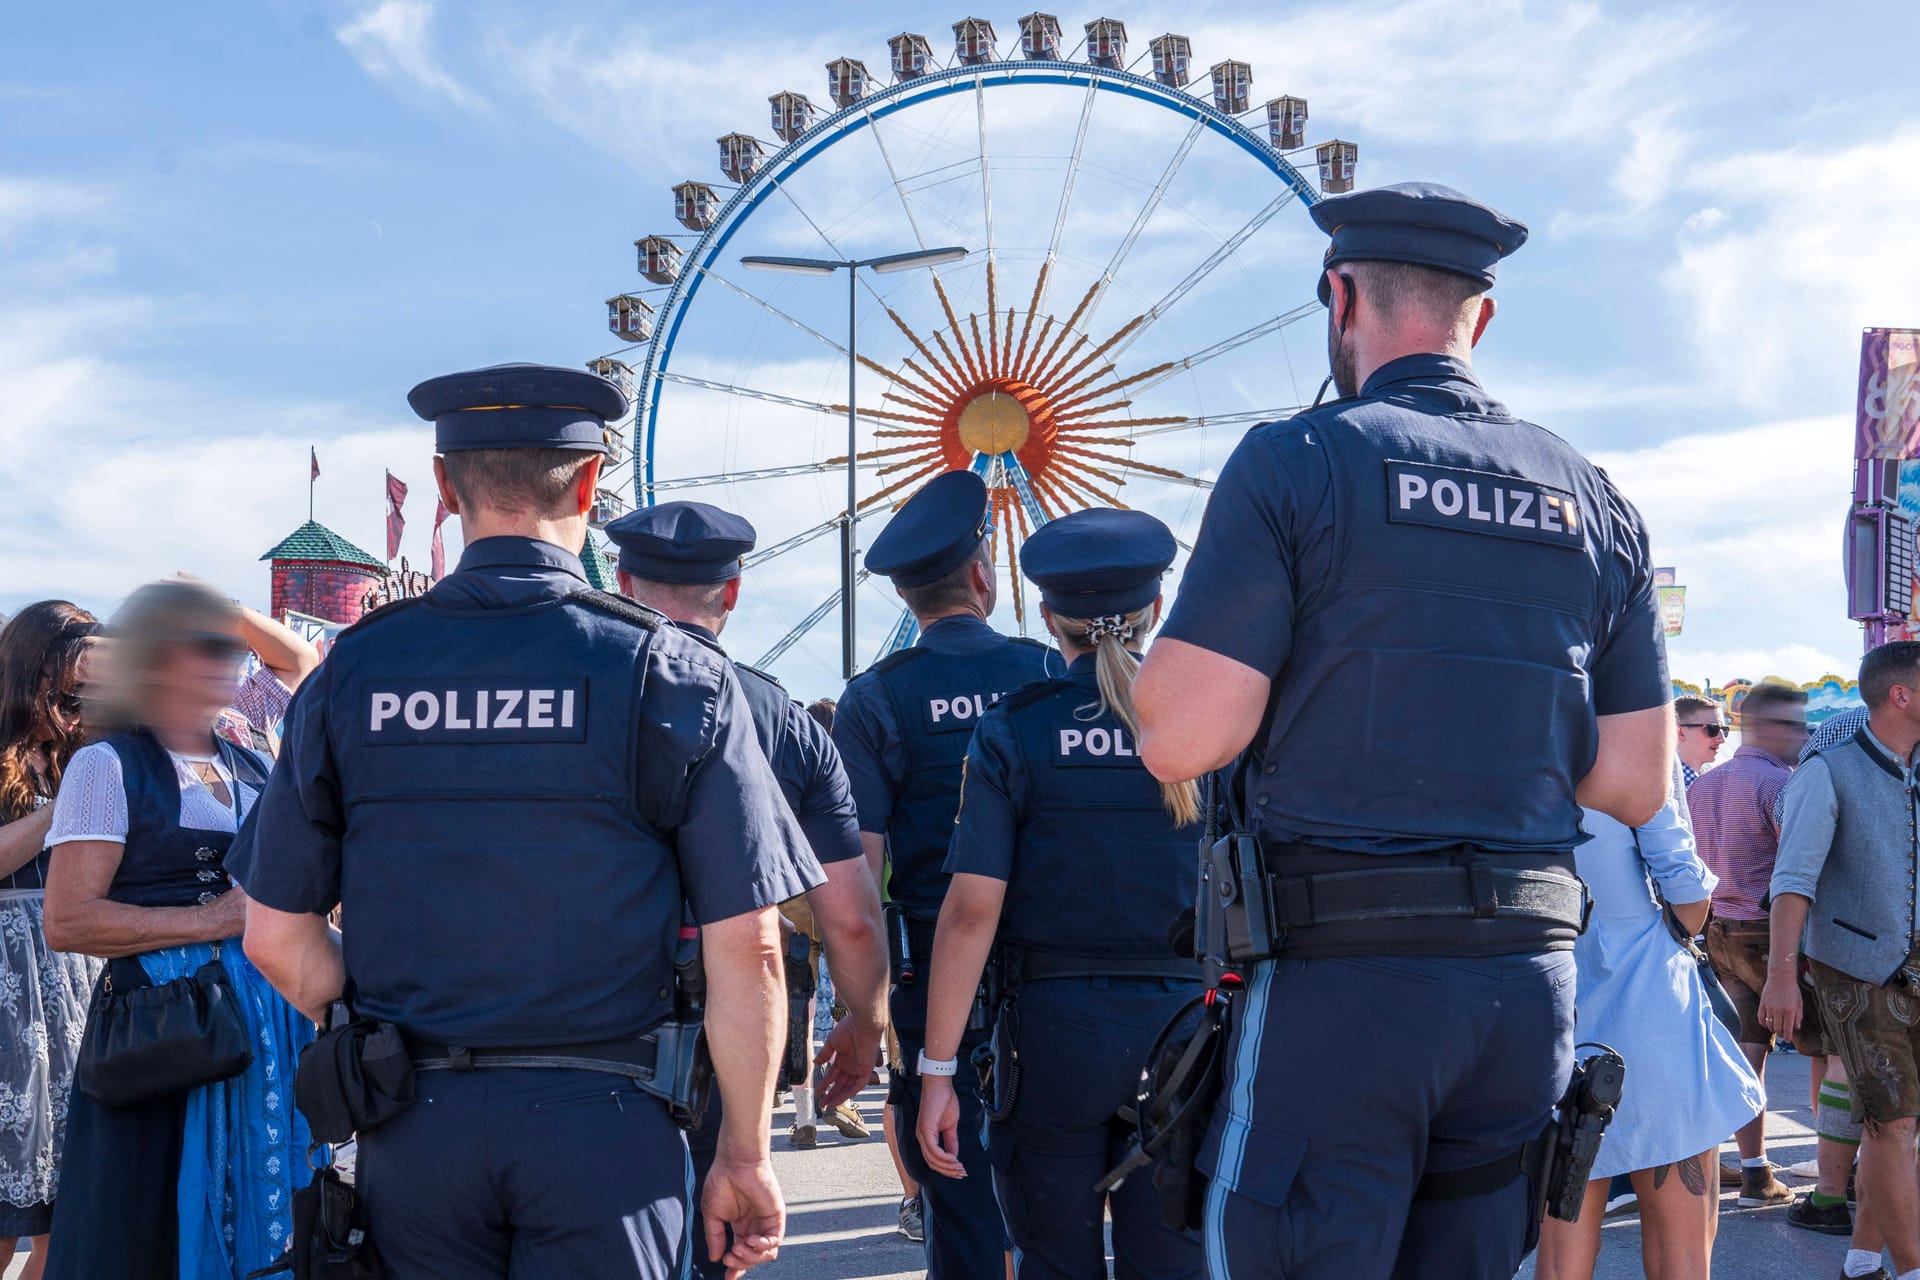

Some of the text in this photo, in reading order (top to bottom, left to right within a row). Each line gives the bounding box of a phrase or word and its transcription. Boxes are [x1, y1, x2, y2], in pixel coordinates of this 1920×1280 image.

[1398, 473, 1578, 536] POLIZEI
[370, 689, 575, 732] POLIZEI
[929, 692, 1007, 723] POL
